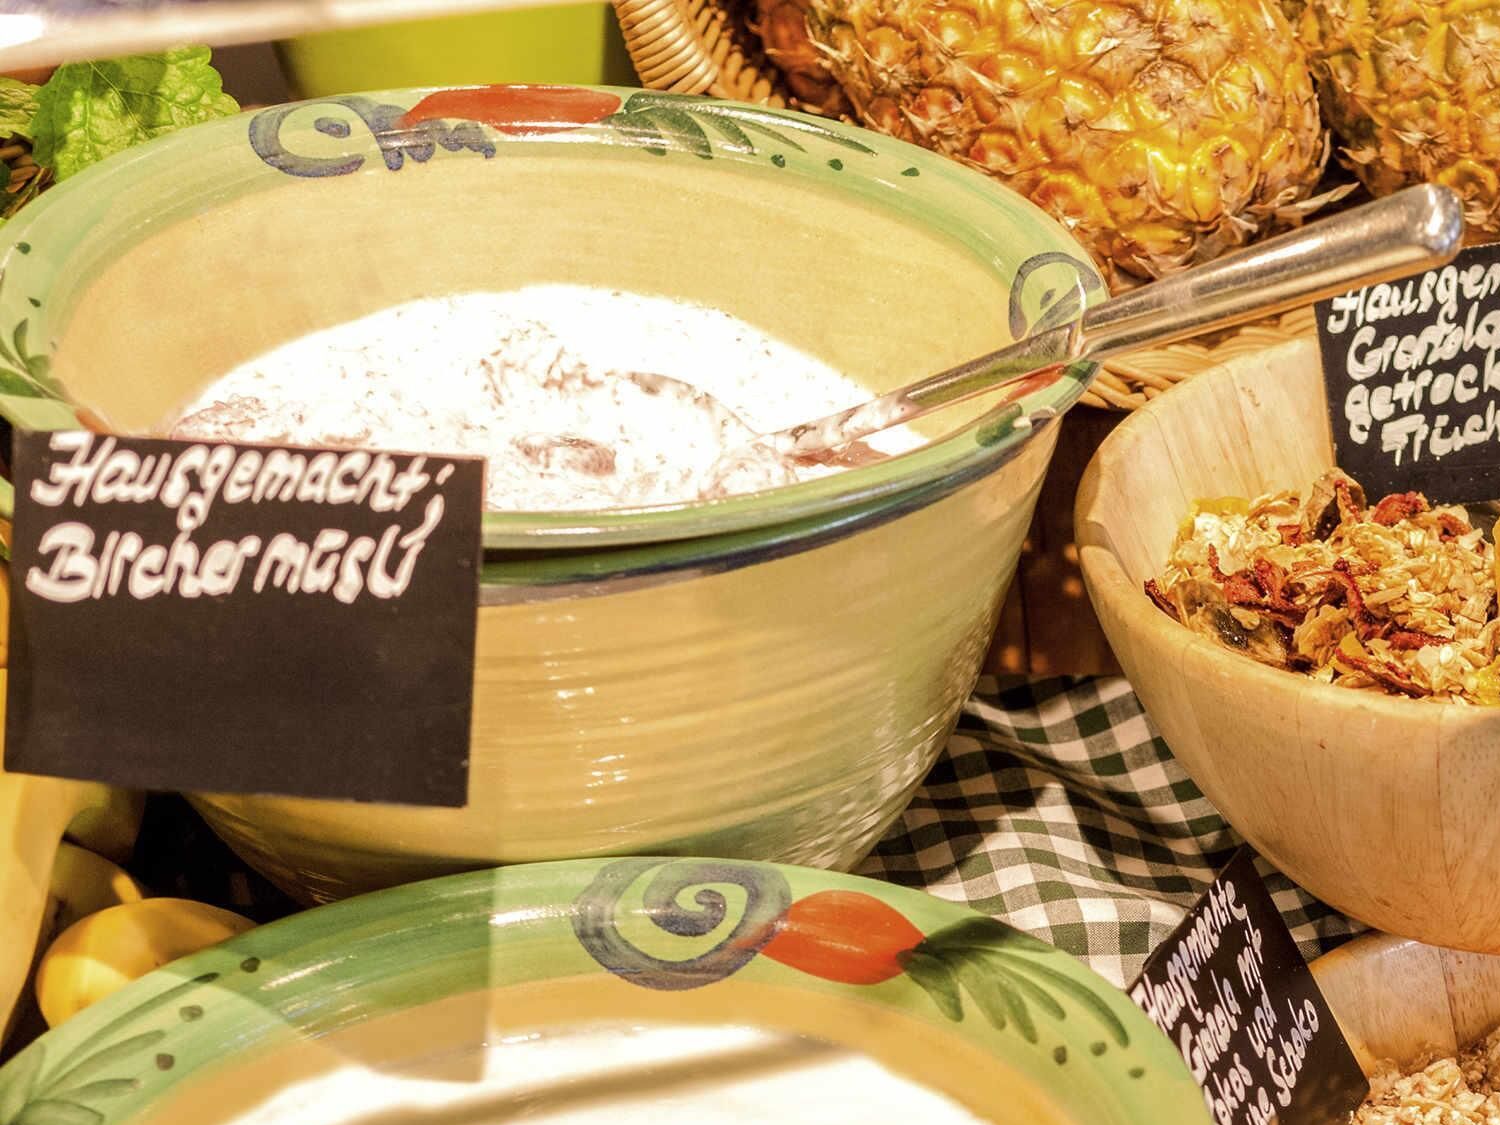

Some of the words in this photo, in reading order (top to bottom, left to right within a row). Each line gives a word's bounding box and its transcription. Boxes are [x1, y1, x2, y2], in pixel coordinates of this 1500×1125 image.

[1130, 879, 1248, 1036] Hausgemachte
[1180, 968, 1242, 1088] Granola
[1237, 914, 1264, 997] mit
[1247, 977, 1277, 1058] und
[1266, 997, 1320, 1107] Schoko
